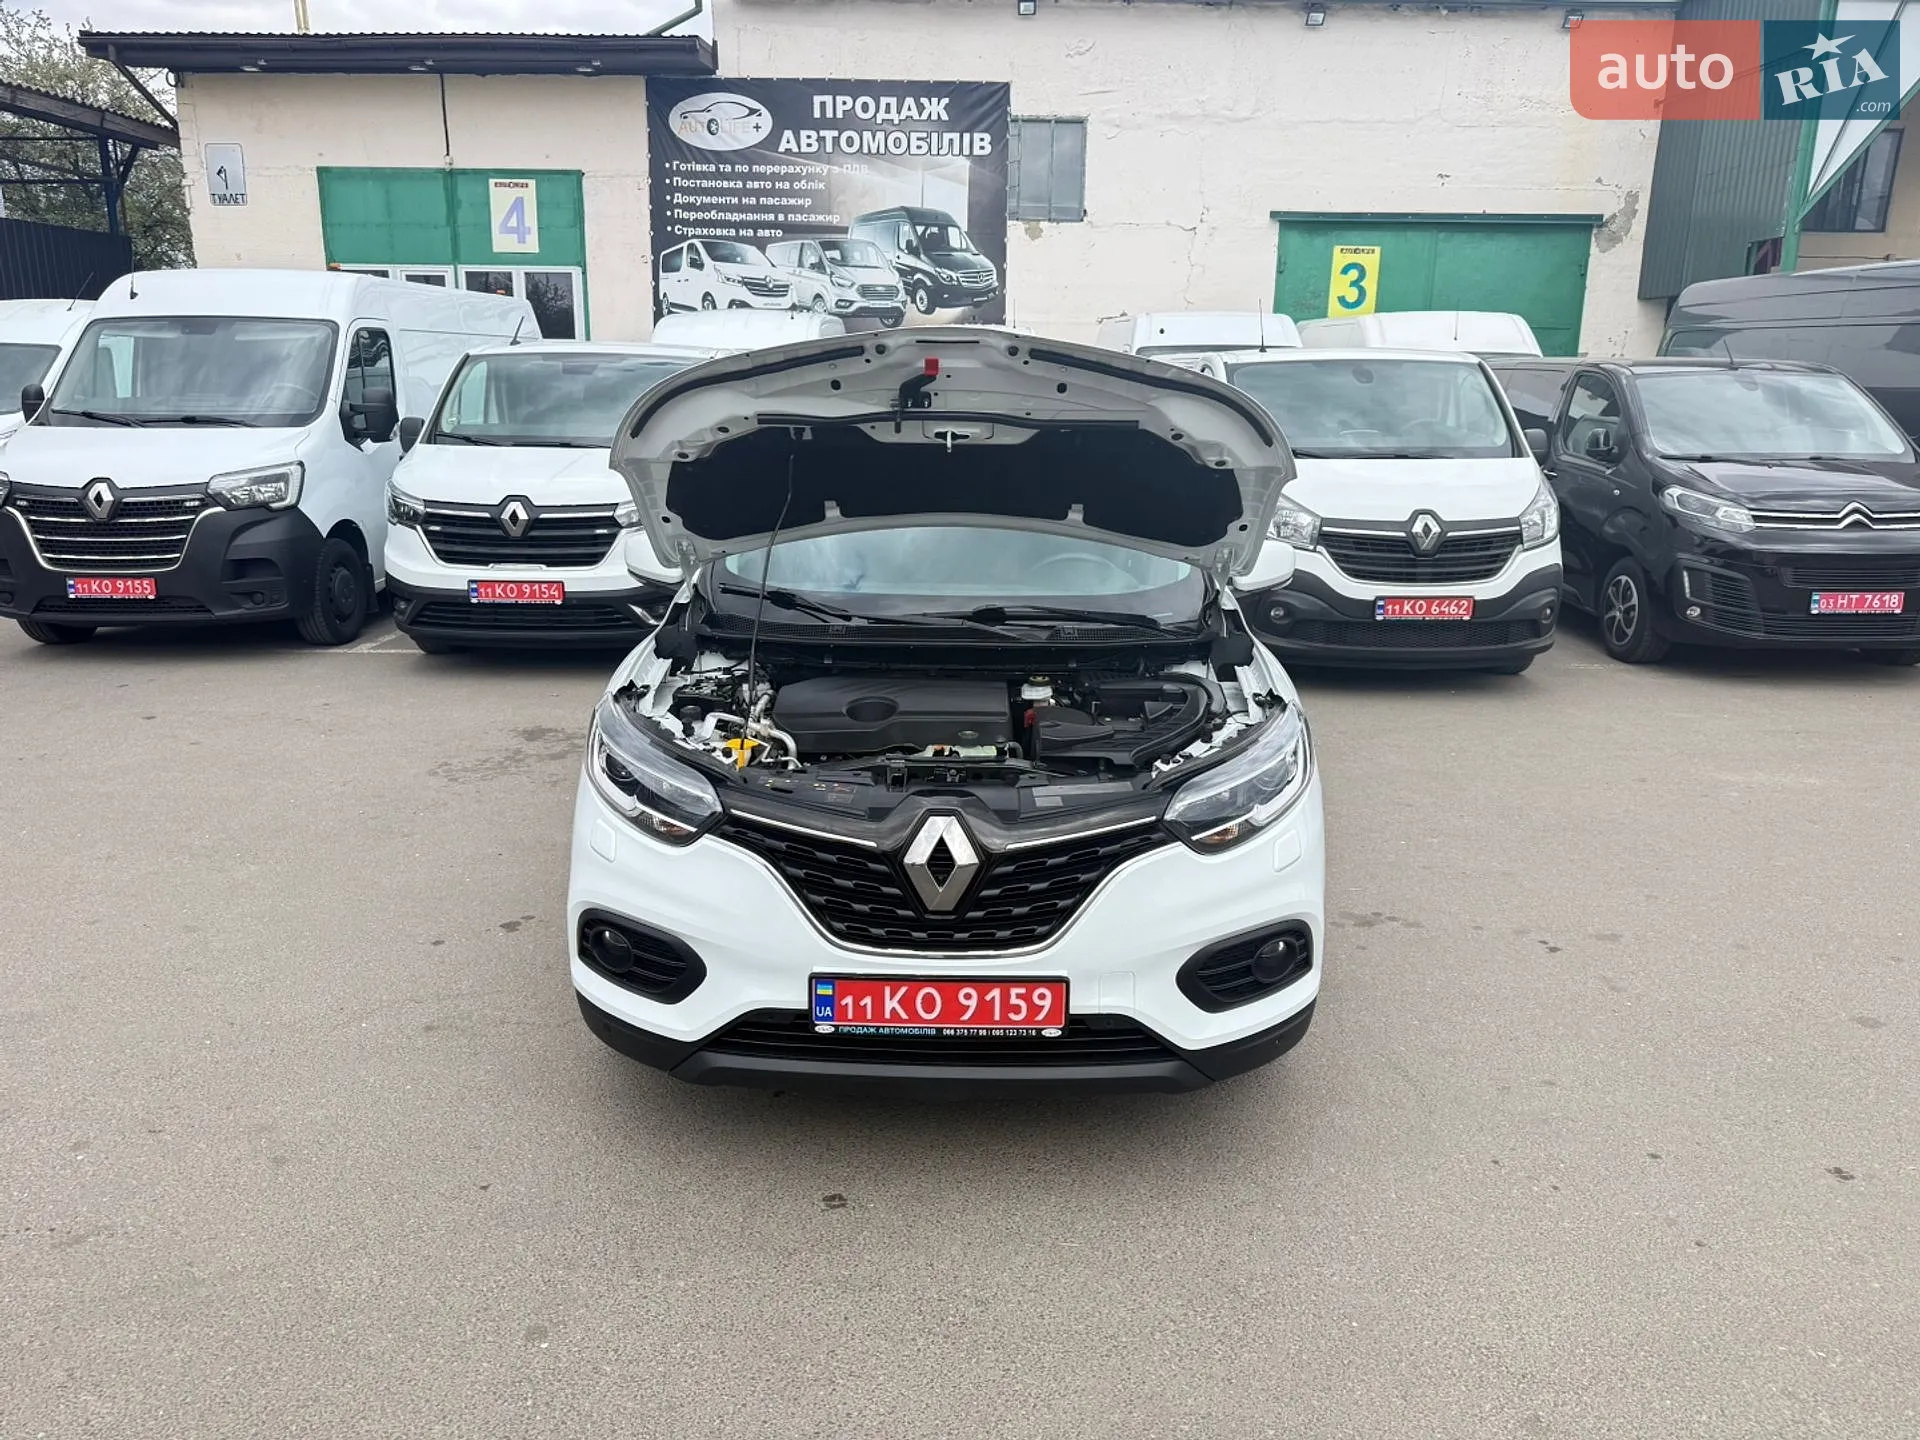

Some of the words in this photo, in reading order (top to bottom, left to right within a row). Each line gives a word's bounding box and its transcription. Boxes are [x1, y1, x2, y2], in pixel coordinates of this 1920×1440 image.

[812, 94, 950, 124] ПРОДАЖ
[777, 129, 992, 156] АВТОМОБІЛІВ
[673, 161, 716, 172] Готівка
[719, 163, 732, 172] та
[735, 164, 749, 172] по
[752, 164, 829, 175] перерахунку
[673, 177, 743, 187] Постановка
[746, 181, 772, 189] авто
[775, 181, 790, 189] на
[793, 179, 826, 189] облік
[673, 193, 739, 206] Документи
[742, 196, 756, 204] на
[759, 197, 812, 207] пасажир
[499, 196, 531, 245] 4
[674, 209, 775, 222] Переобладнання
[788, 214, 841, 224] пасажир
[674, 225, 736, 237] Страховка
[739, 228, 754, 236] на
[757, 229, 783, 237] авто
[1337, 262, 1367, 310] 3
[76, 583, 88, 593] 11
[116, 580, 151, 593] 9155
[479, 588, 492, 597] 11
[522, 584, 559, 598] 9154
[1387, 605, 1400, 614] 11
[1431, 600, 1468, 614] 6462
[1820, 599, 1834, 609] 03
[1864, 595, 1899, 608] 7618
[840, 995, 873, 1020] 11
[957, 987, 1053, 1021] 9159
[816, 1006, 833, 1018] UA
[838, 1026, 877, 1034] ПРОДАЖ
